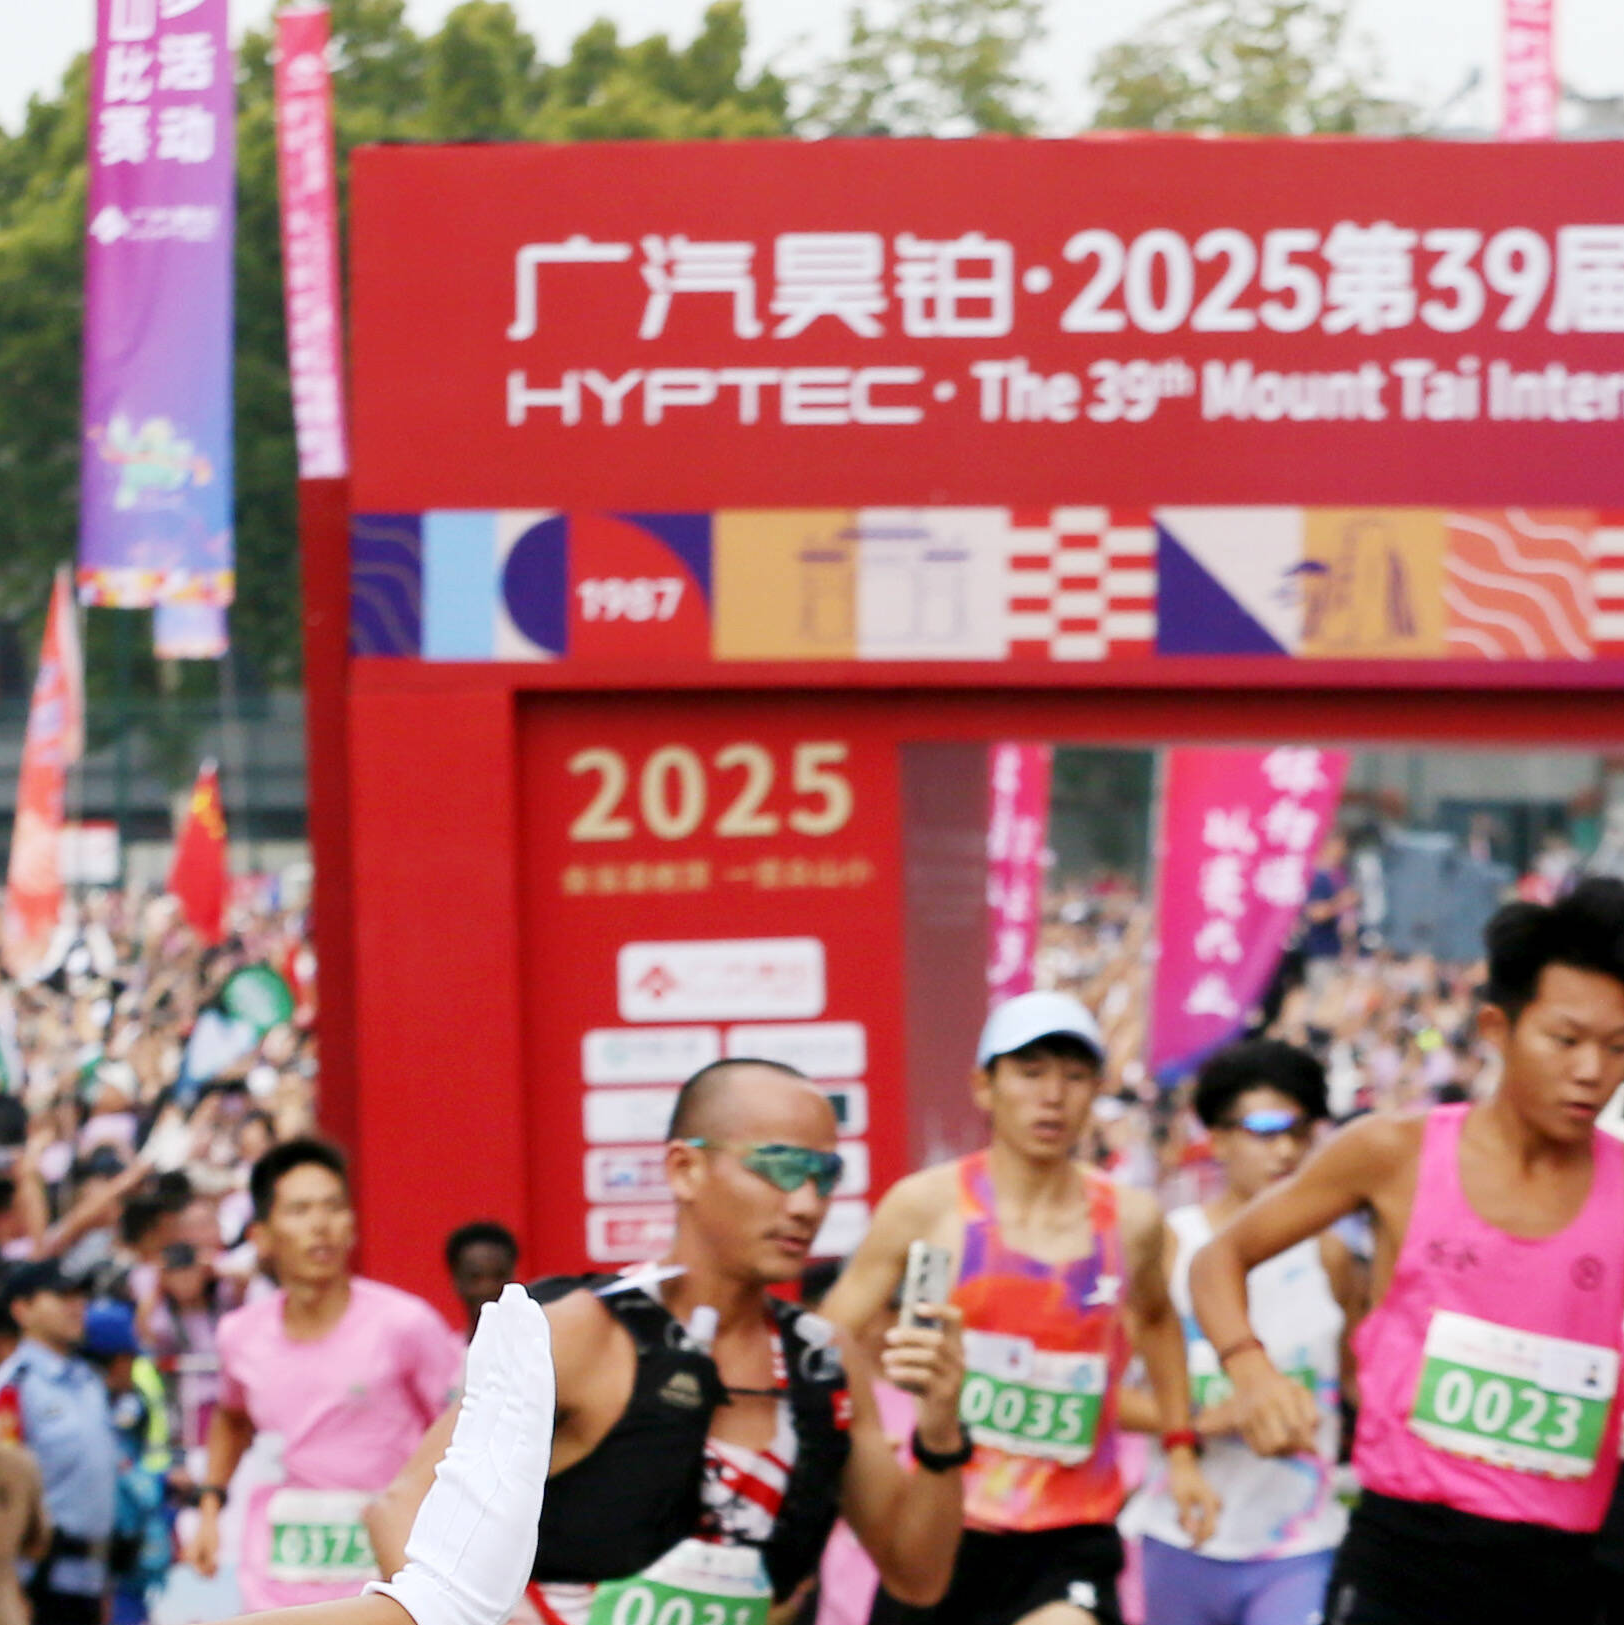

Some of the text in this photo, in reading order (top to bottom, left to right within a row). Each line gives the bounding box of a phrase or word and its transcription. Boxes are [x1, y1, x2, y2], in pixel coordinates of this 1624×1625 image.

[505, 367, 925, 426] HYPTEC
[971, 356, 1081, 423] The
[1087, 356, 1195, 423] 39th
[1200, 358, 1385, 422] Mount
[1391, 356, 1481, 422] Tai
[576, 576, 684, 624] 1987
[565, 741, 855, 842] 2025
[958, 1376, 1086, 1443] 0035
[1432, 1368, 1584, 1449] 0023
